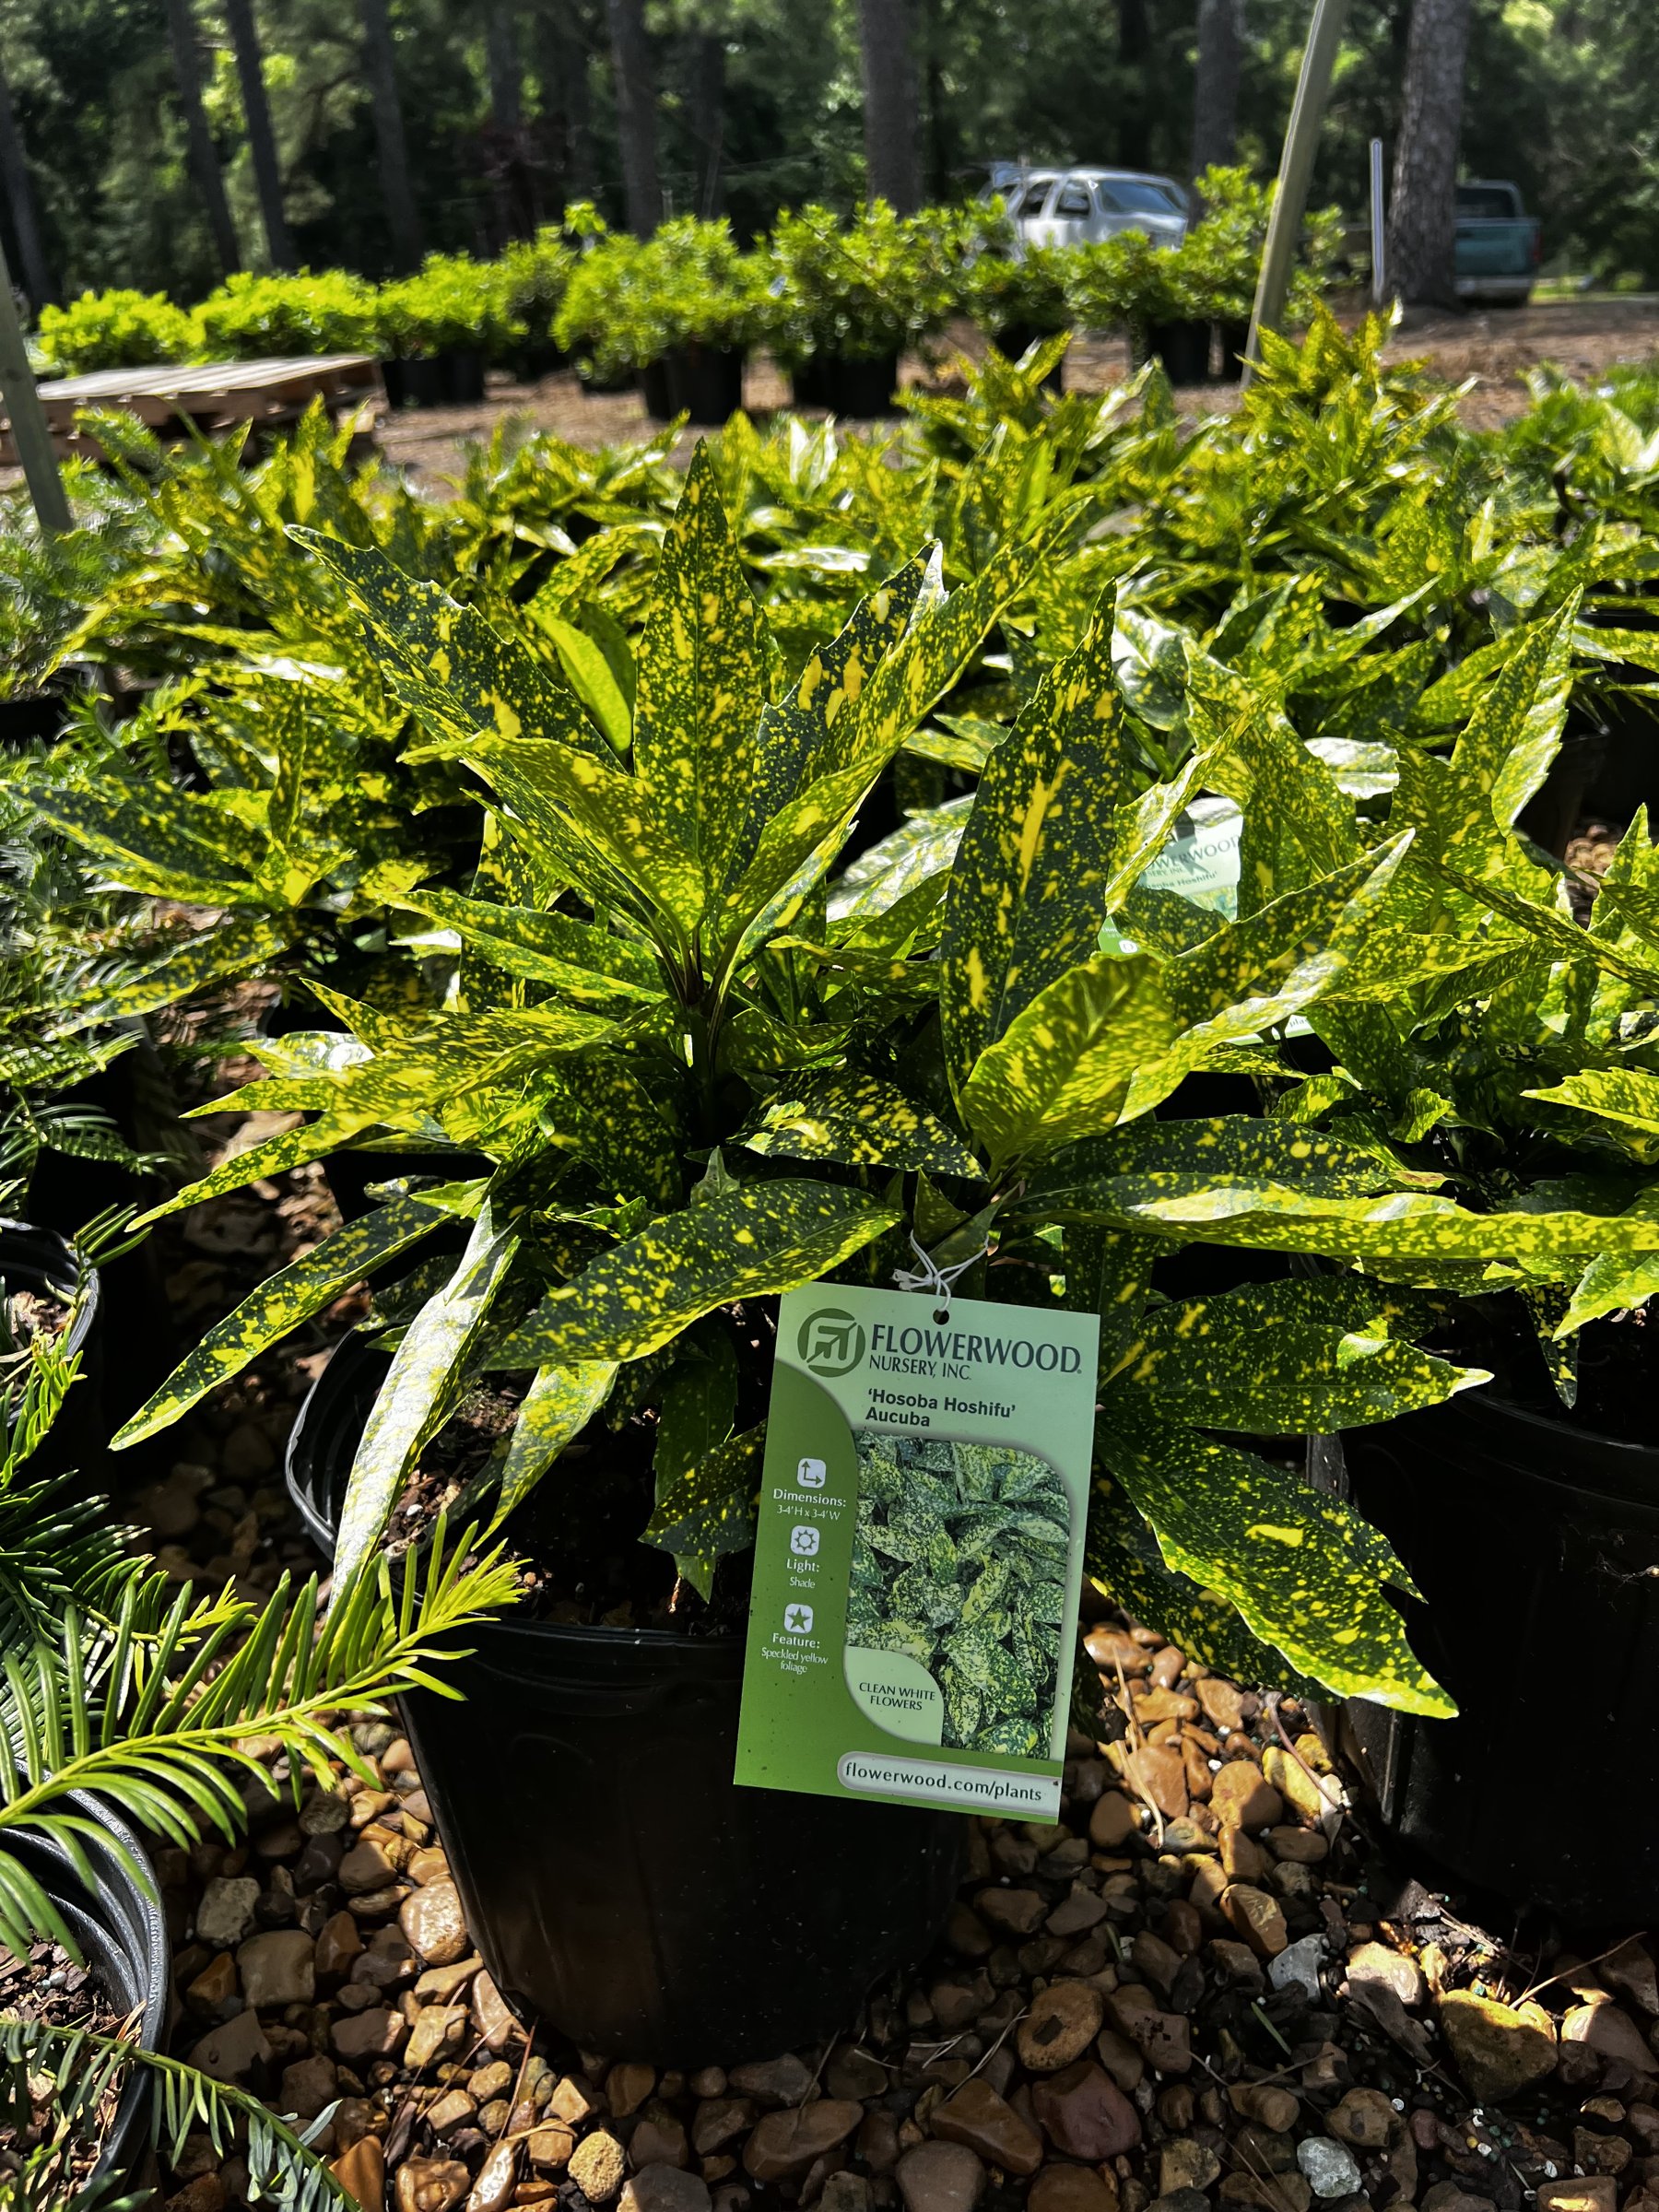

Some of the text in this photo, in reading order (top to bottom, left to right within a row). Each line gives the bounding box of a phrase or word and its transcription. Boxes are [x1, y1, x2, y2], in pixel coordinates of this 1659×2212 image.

[871, 1324, 1082, 1374] FLOWERWOOD
[869, 1355, 937, 1379] NURSERY,
[868, 1387, 1017, 1418] 'Hosoba Hoshifu'
[865, 1406, 931, 1428] Aucuba
[773, 1488, 847, 1508] Dimensions:
[786, 1558, 820, 1573] Light:
[790, 1576, 816, 1589] Shade
[772, 1632, 821, 1649] Feature:
[761, 1646, 829, 1665] Speckled yellow
[780, 1660, 808, 1676] foliage
[859, 1682, 937, 1701] CLEAN WHITE
[870, 1695, 924, 1712] FLOWERS
[845, 1761, 1042, 1801] flowerwood.com/plants
